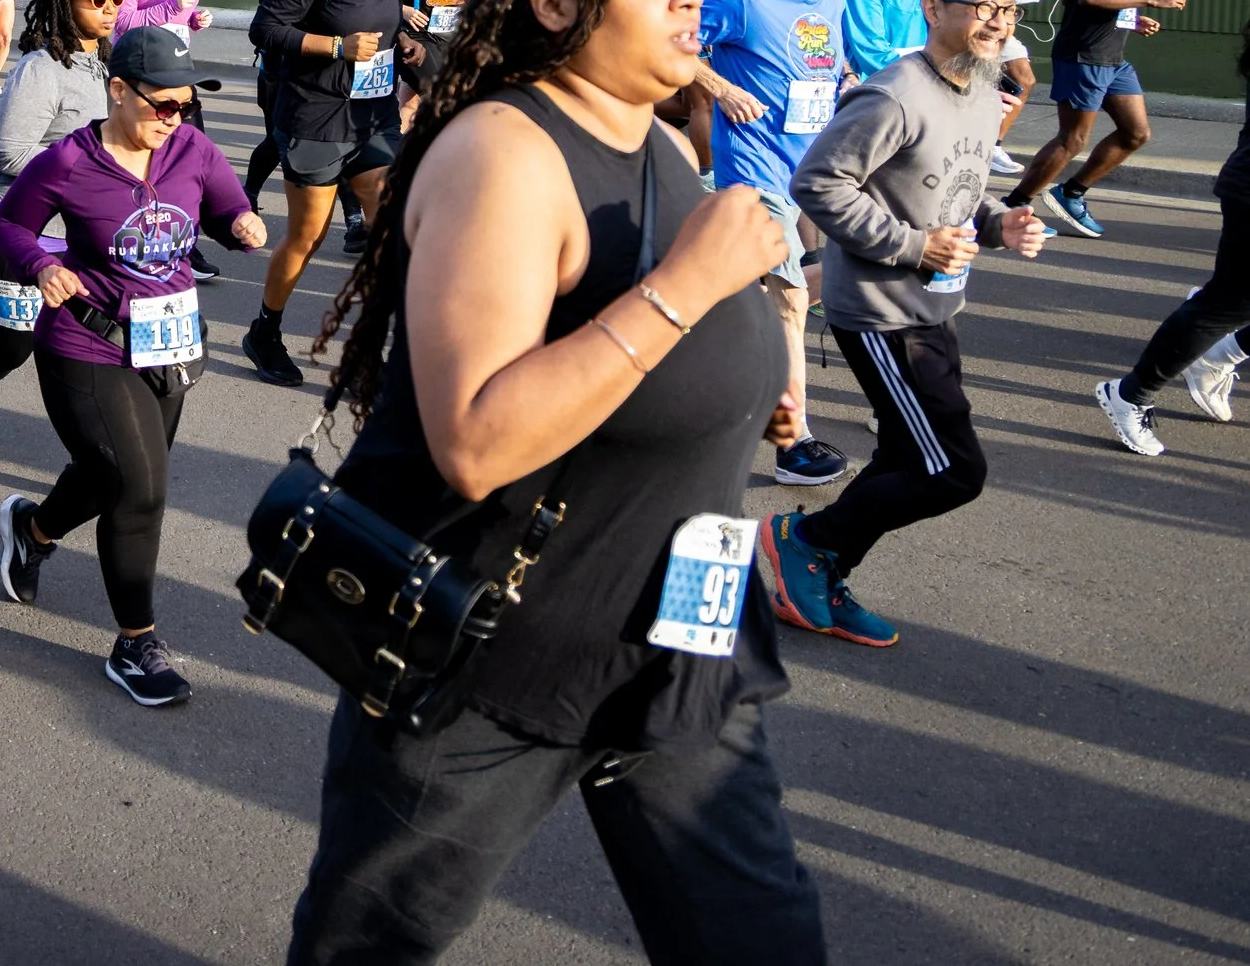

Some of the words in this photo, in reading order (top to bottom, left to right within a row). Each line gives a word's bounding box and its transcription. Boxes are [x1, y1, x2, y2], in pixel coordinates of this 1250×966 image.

[363, 67, 389, 89] 262
[800, 99, 831, 123] 143
[922, 137, 991, 190] OAKLA
[145, 212, 171, 225] 2020
[108, 246, 137, 256] RUN
[143, 236, 196, 254] OAKLAN
[8, 298, 45, 321] 131
[151, 315, 194, 351] 119
[781, 516, 790, 540] HOKA
[698, 565, 740, 626] 93
